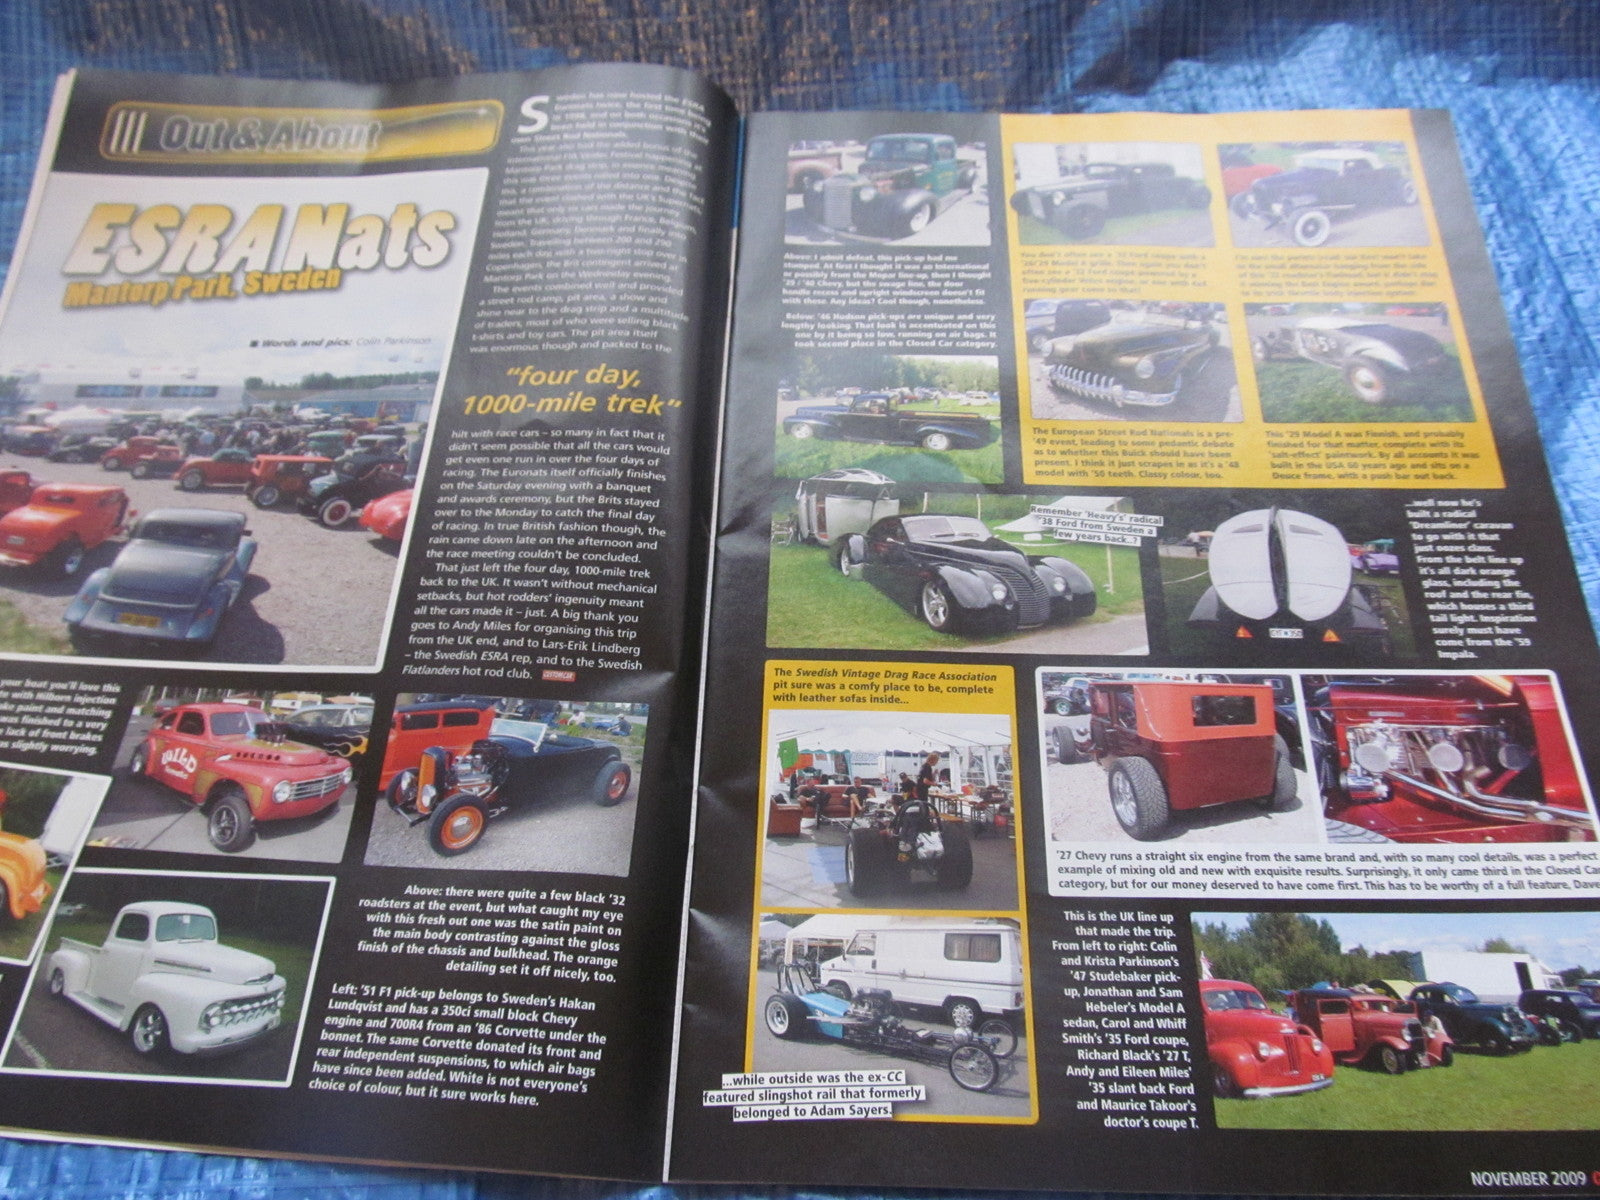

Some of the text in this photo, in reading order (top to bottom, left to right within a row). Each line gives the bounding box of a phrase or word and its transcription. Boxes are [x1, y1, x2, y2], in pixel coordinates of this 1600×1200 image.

[160, 116, 383, 153] Out & About
[63, 203, 457, 275] ESRA Nats
[64, 268, 340, 309] Mantorp Park, Sweden
[261, 336, 431, 348] Words and pics: Colin Parkinson
[507, 363, 642, 389] "four day,
[464, 392, 682, 416] 1000-mile trek"
[1031, 506, 1082, 516] Remember
[1130, 516, 1162, 524] radical
[1038, 517, 1052, 525] '38
[1056, 519, 1077, 527] Ford
[1080, 522, 1103, 530] from
[1106, 524, 1144, 534] Sweden
[1076, 532, 1101, 540] years
[408, 634, 640, 656] from the UK end, and to Lars-Erik Lindberg
[401, 664, 532, 678] Flatlanders hot rod club.
[774, 667, 996, 681] The Swedish Vintage Drag Race Association
[772, 679, 787, 690] pit
[848, 681, 880, 695] comfy
[883, 682, 910, 695] place
[913, 683, 924, 692] to
[927, 683, 942, 693] be,
[946, 684, 993, 695] complete
[772, 692, 796, 701] with
[799, 692, 836, 702] leather
[839, 693, 866, 702] sofas
[12, 740, 97, 755] slightly worrying.
[1056, 850, 1071, 859] '27
[1074, 850, 1106, 862] Chevy
[1144, 850, 1186, 863] straight
[1188, 851, 1203, 861] six
[1206, 851, 1242, 864] engine
[1244, 851, 1270, 861] from
[1273, 851, 1291, 861] the
[1294, 854, 1321, 862] same
[1324, 852, 1356, 862] brand
[1358, 852, 1381, 862] and,
[1383, 852, 1408, 862] with
[1410, 854, 1423, 862] so
[1425, 854, 1454, 864] many
[1457, 852, 1480, 862] cool
[1483, 852, 1522, 861] details,
[1524, 853, 1546, 861] was
[1558, 850, 1598, 862] perfect
[404, 884, 625, 905] Above: there were quite a few black '32
[1063, 910, 1173, 924] This is the UK line up
[1075, 925, 1175, 938] that made the trip.
[1051, 940, 1177, 953] From left to right: Colin
[1060, 954, 1179, 966] and Krista Parkinson's
[1070, 970, 1180, 984] '47 Studebaker pick-
[332, 982, 595, 1010] Left: '51 F1 pick-up belongs to Sweden's Hakan
[769, 1074, 813, 1084] outside
[817, 1075, 840, 1083] was
[844, 1073, 863, 1083] the
[868, 1072, 903, 1082] ex-CC
[703, 1087, 921, 1103] featured slingshot rail that formerly
[734, 1105, 892, 1120] belonged to Adam Sayers.
[1471, 1172, 1550, 1186] NOVEMBER
[1551, 1171, 1586, 1185] 2009
